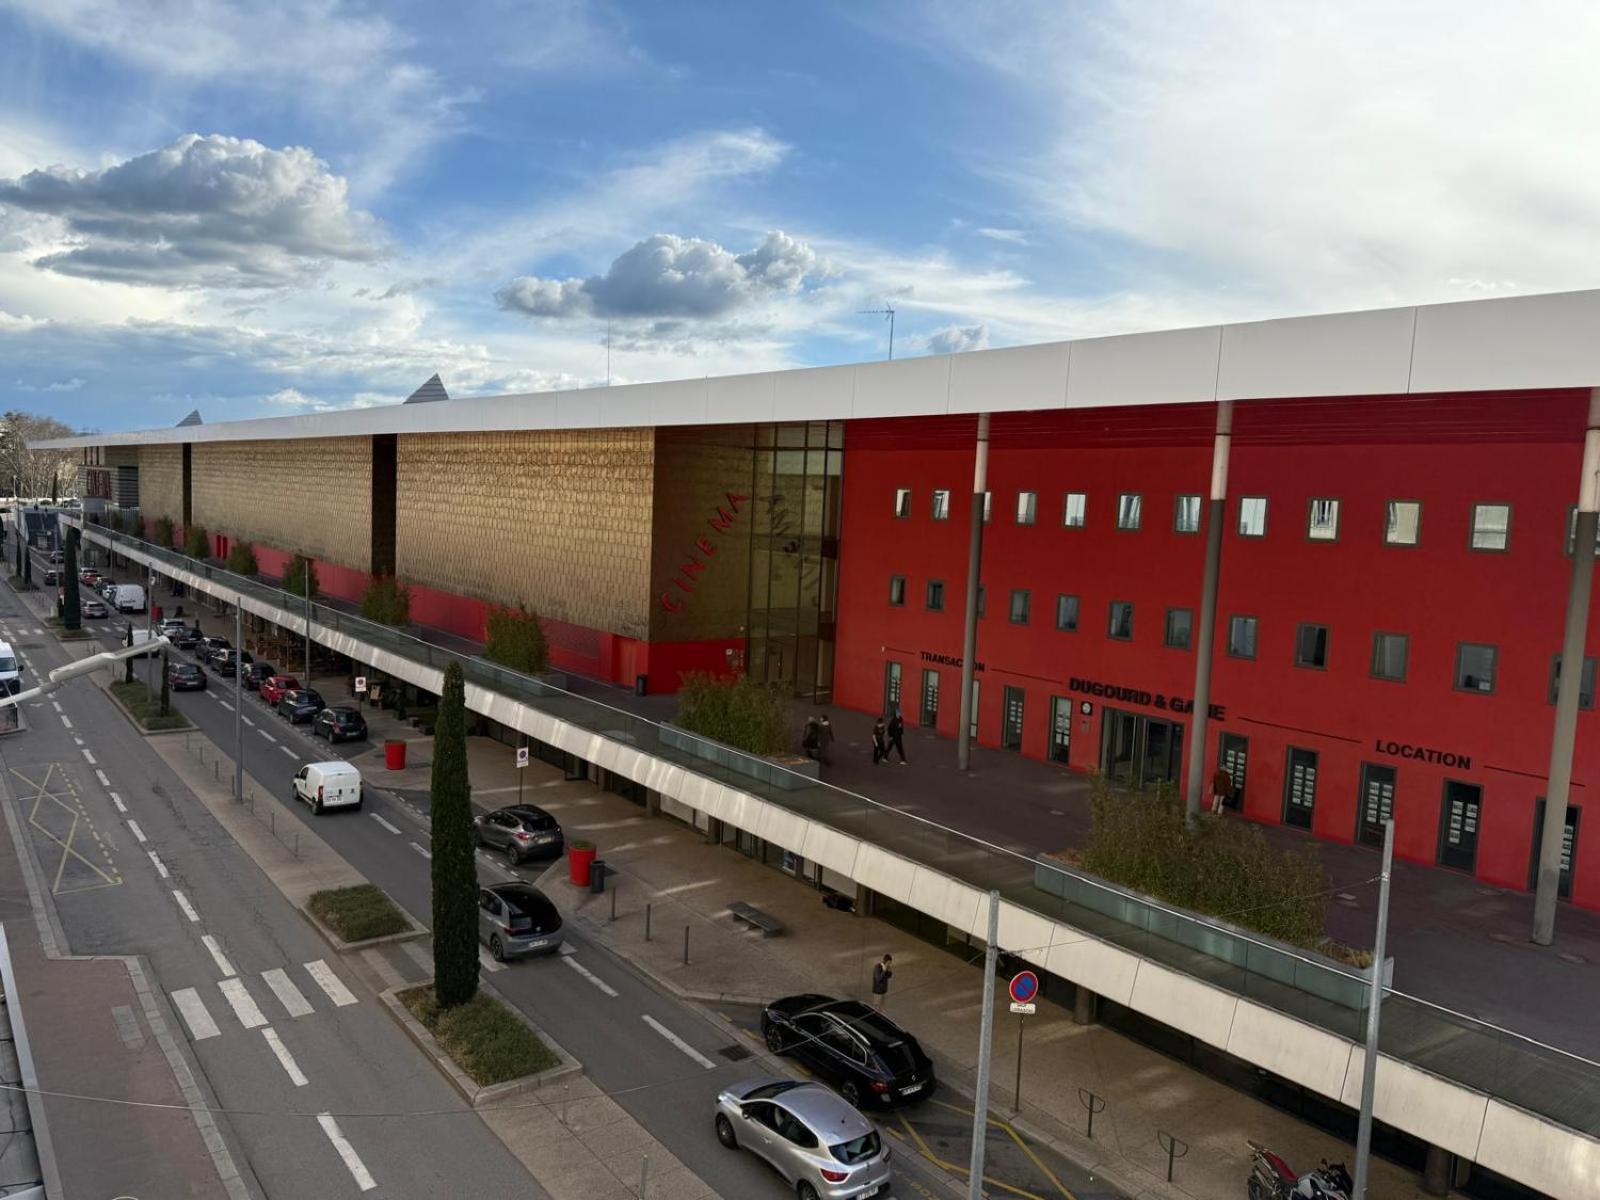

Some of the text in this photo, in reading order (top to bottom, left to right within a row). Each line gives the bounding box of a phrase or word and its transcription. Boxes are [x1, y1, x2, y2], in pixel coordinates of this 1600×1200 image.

[660, 492, 751, 613] CINEMA
[920, 651, 985, 672] TRANSACON
[1069, 677, 1152, 706] DUGOURD
[1154, 694, 1169, 711] &
[1376, 740, 1471, 768] LOCATION
